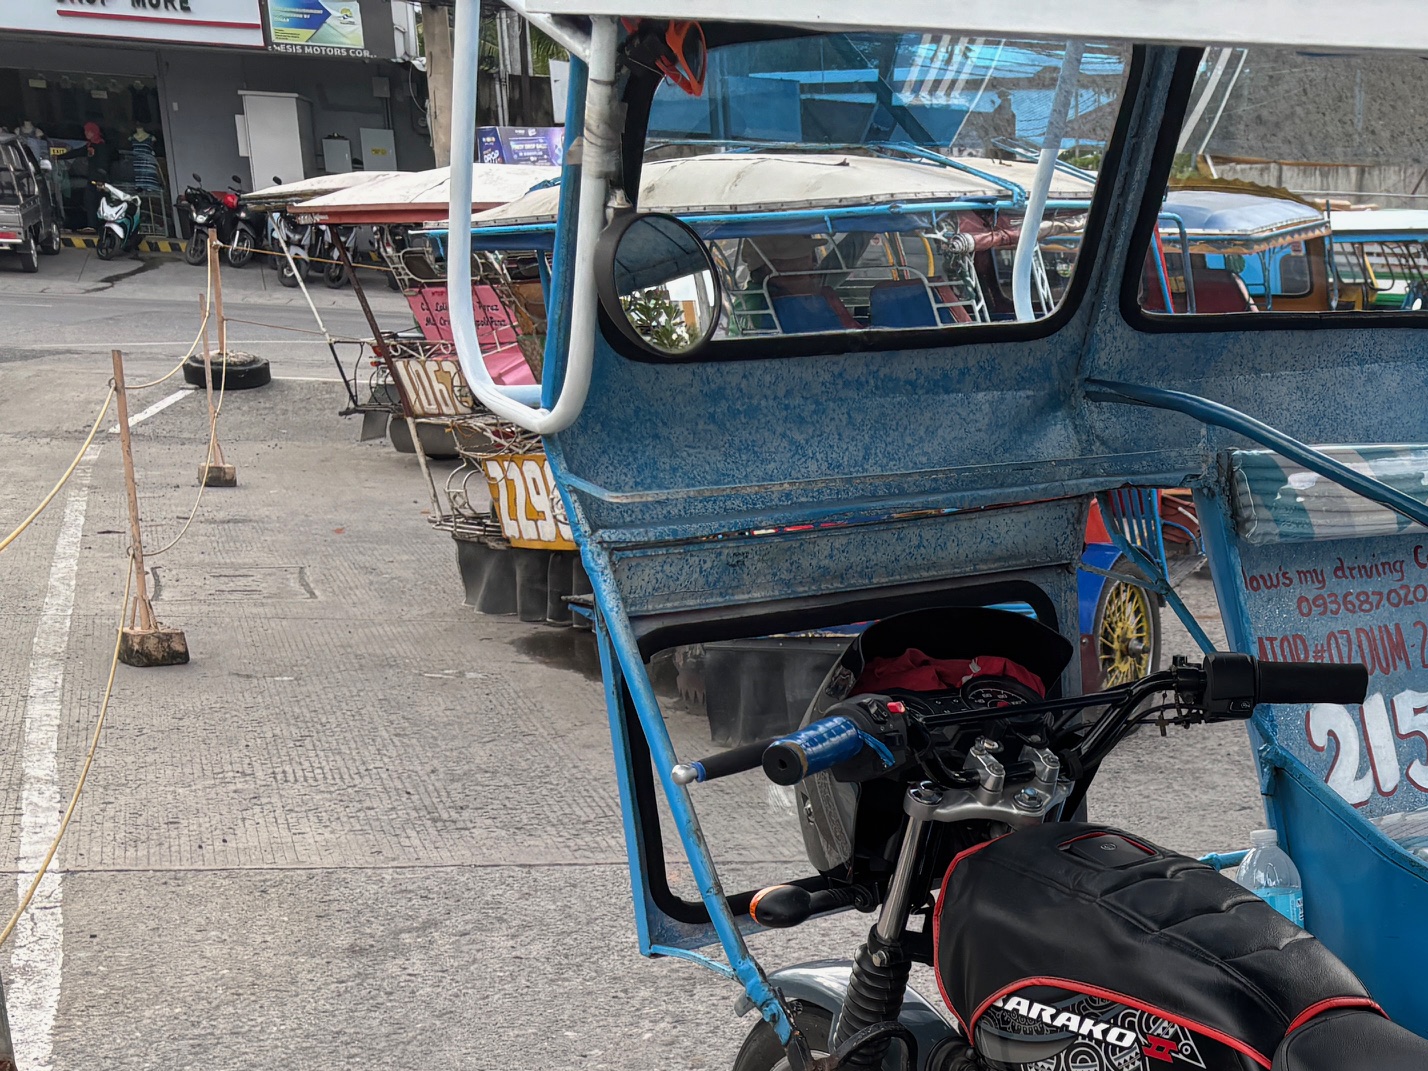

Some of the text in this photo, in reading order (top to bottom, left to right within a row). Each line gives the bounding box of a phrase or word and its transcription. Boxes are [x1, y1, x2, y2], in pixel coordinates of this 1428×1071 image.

[304, 45, 347, 56] MOTORS
[1296, 567, 1327, 590] my
[1332, 553, 1406, 582] driving
